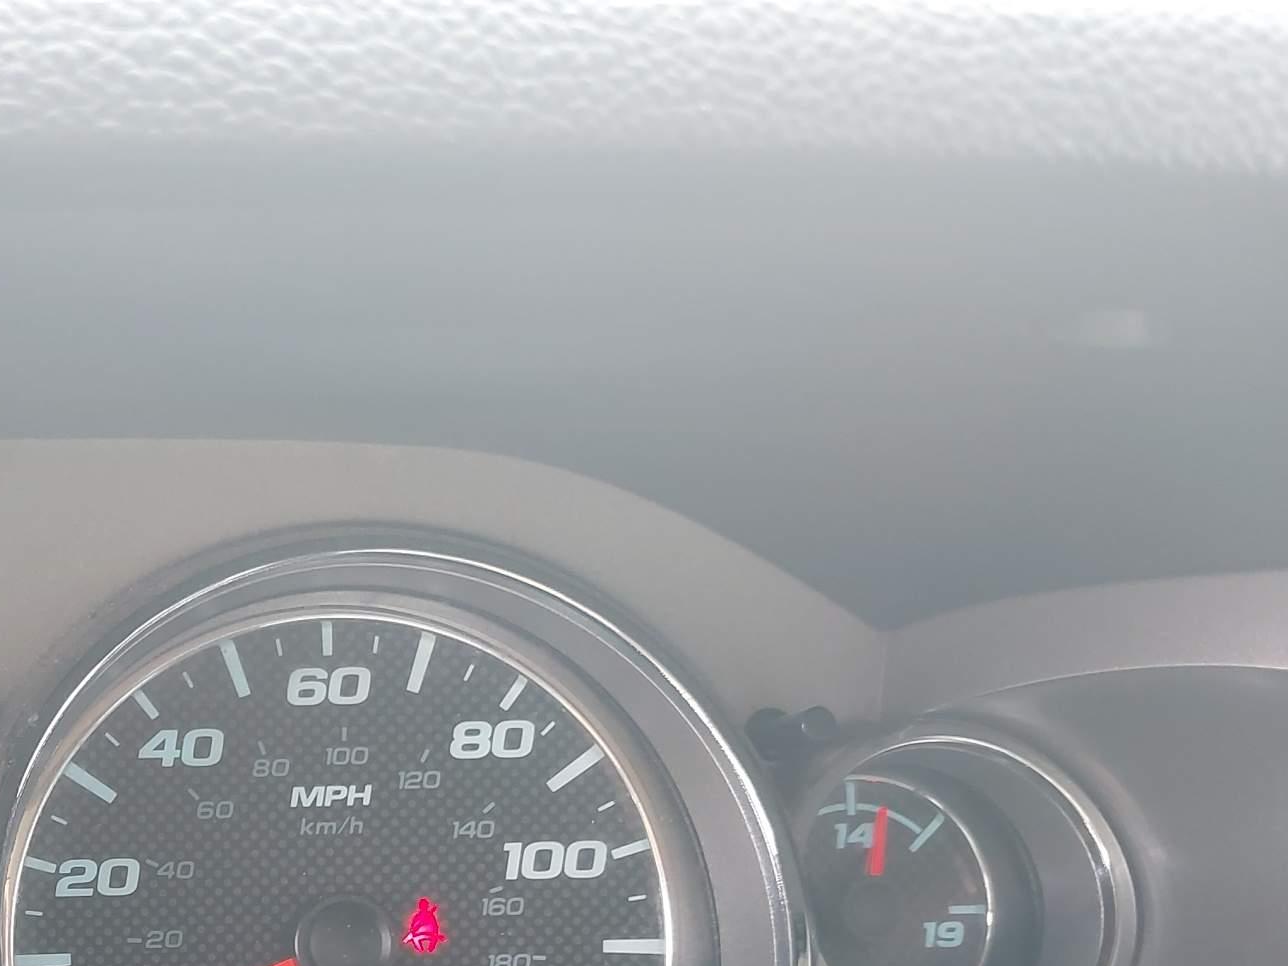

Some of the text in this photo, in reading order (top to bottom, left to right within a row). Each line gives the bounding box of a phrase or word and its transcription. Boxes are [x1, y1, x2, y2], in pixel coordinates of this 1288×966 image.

[286, 667, 371, 705] 60
[138, 729, 224, 766] 40
[450, 720, 534, 758] 80
[325, 746, 369, 765] 100
[252, 758, 289, 777] 80
[398, 771, 441, 790] 120
[290, 785, 371, 807] MPH
[197, 801, 233, 819] 60
[300, 818, 364, 835] km/h
[452, 820, 495, 839] 140
[834, 823, 875, 849] 14
[156, 861, 194, 879] 40
[503, 841, 607, 880] 100
[55, 859, 140, 896] 20
[481, 897, 524, 916] 160
[145, 930, 182, 949] 20
[923, 922, 964, 948] 19
